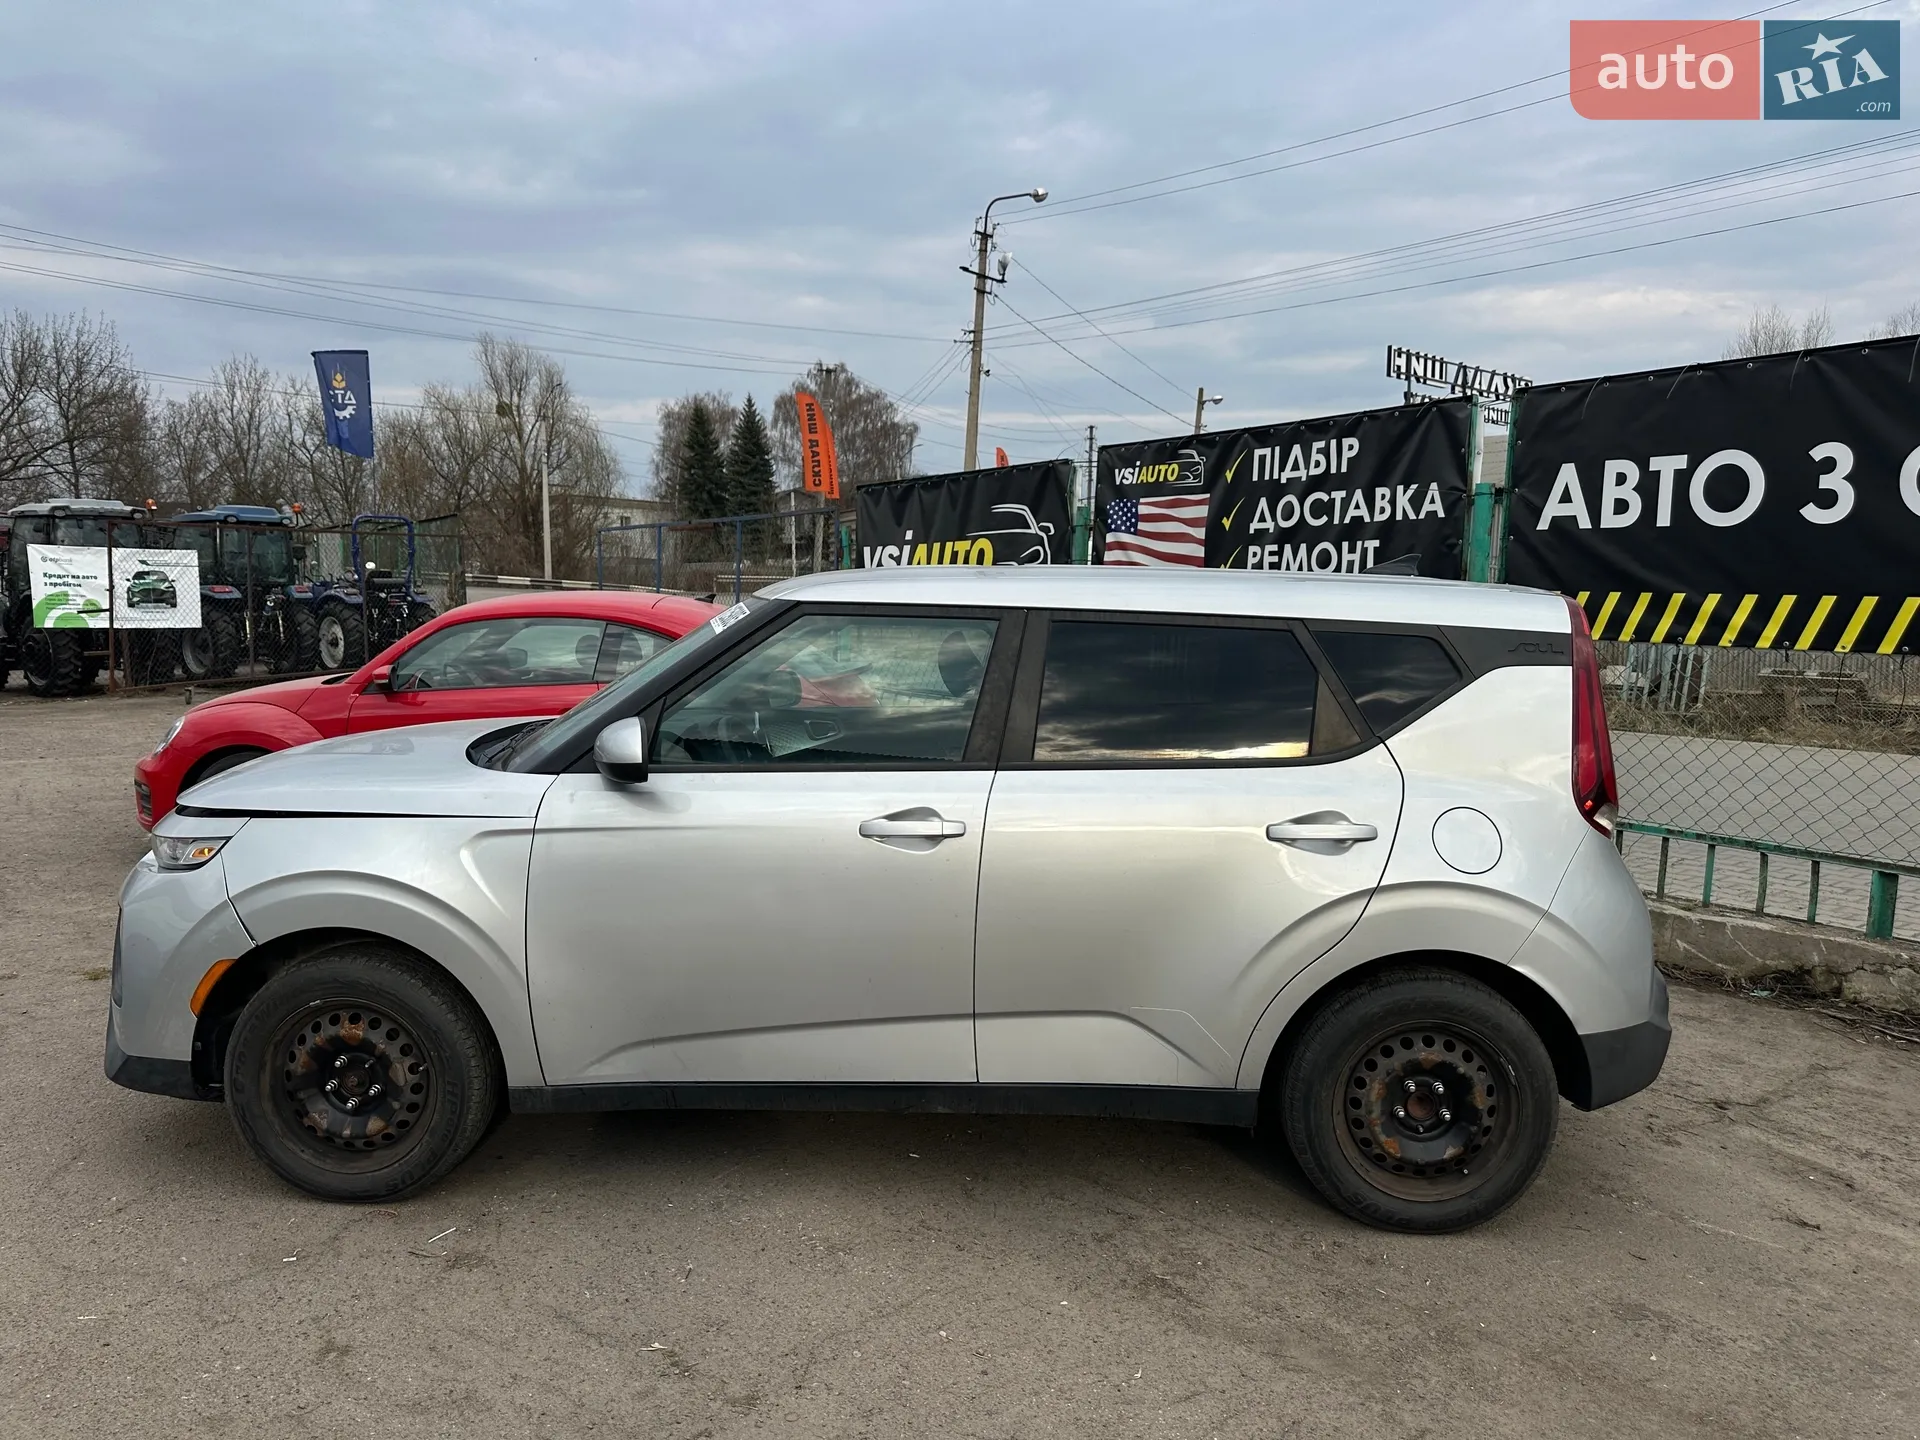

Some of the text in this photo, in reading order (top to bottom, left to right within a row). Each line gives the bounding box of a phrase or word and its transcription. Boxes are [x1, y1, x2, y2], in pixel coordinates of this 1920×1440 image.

[1252, 437, 1360, 483] ПІДБІР
[1249, 482, 1447, 534] ДОСТАВКА
[1535, 449, 1766, 531] АВТО
[1247, 539, 1380, 574] РЕМОНТ
